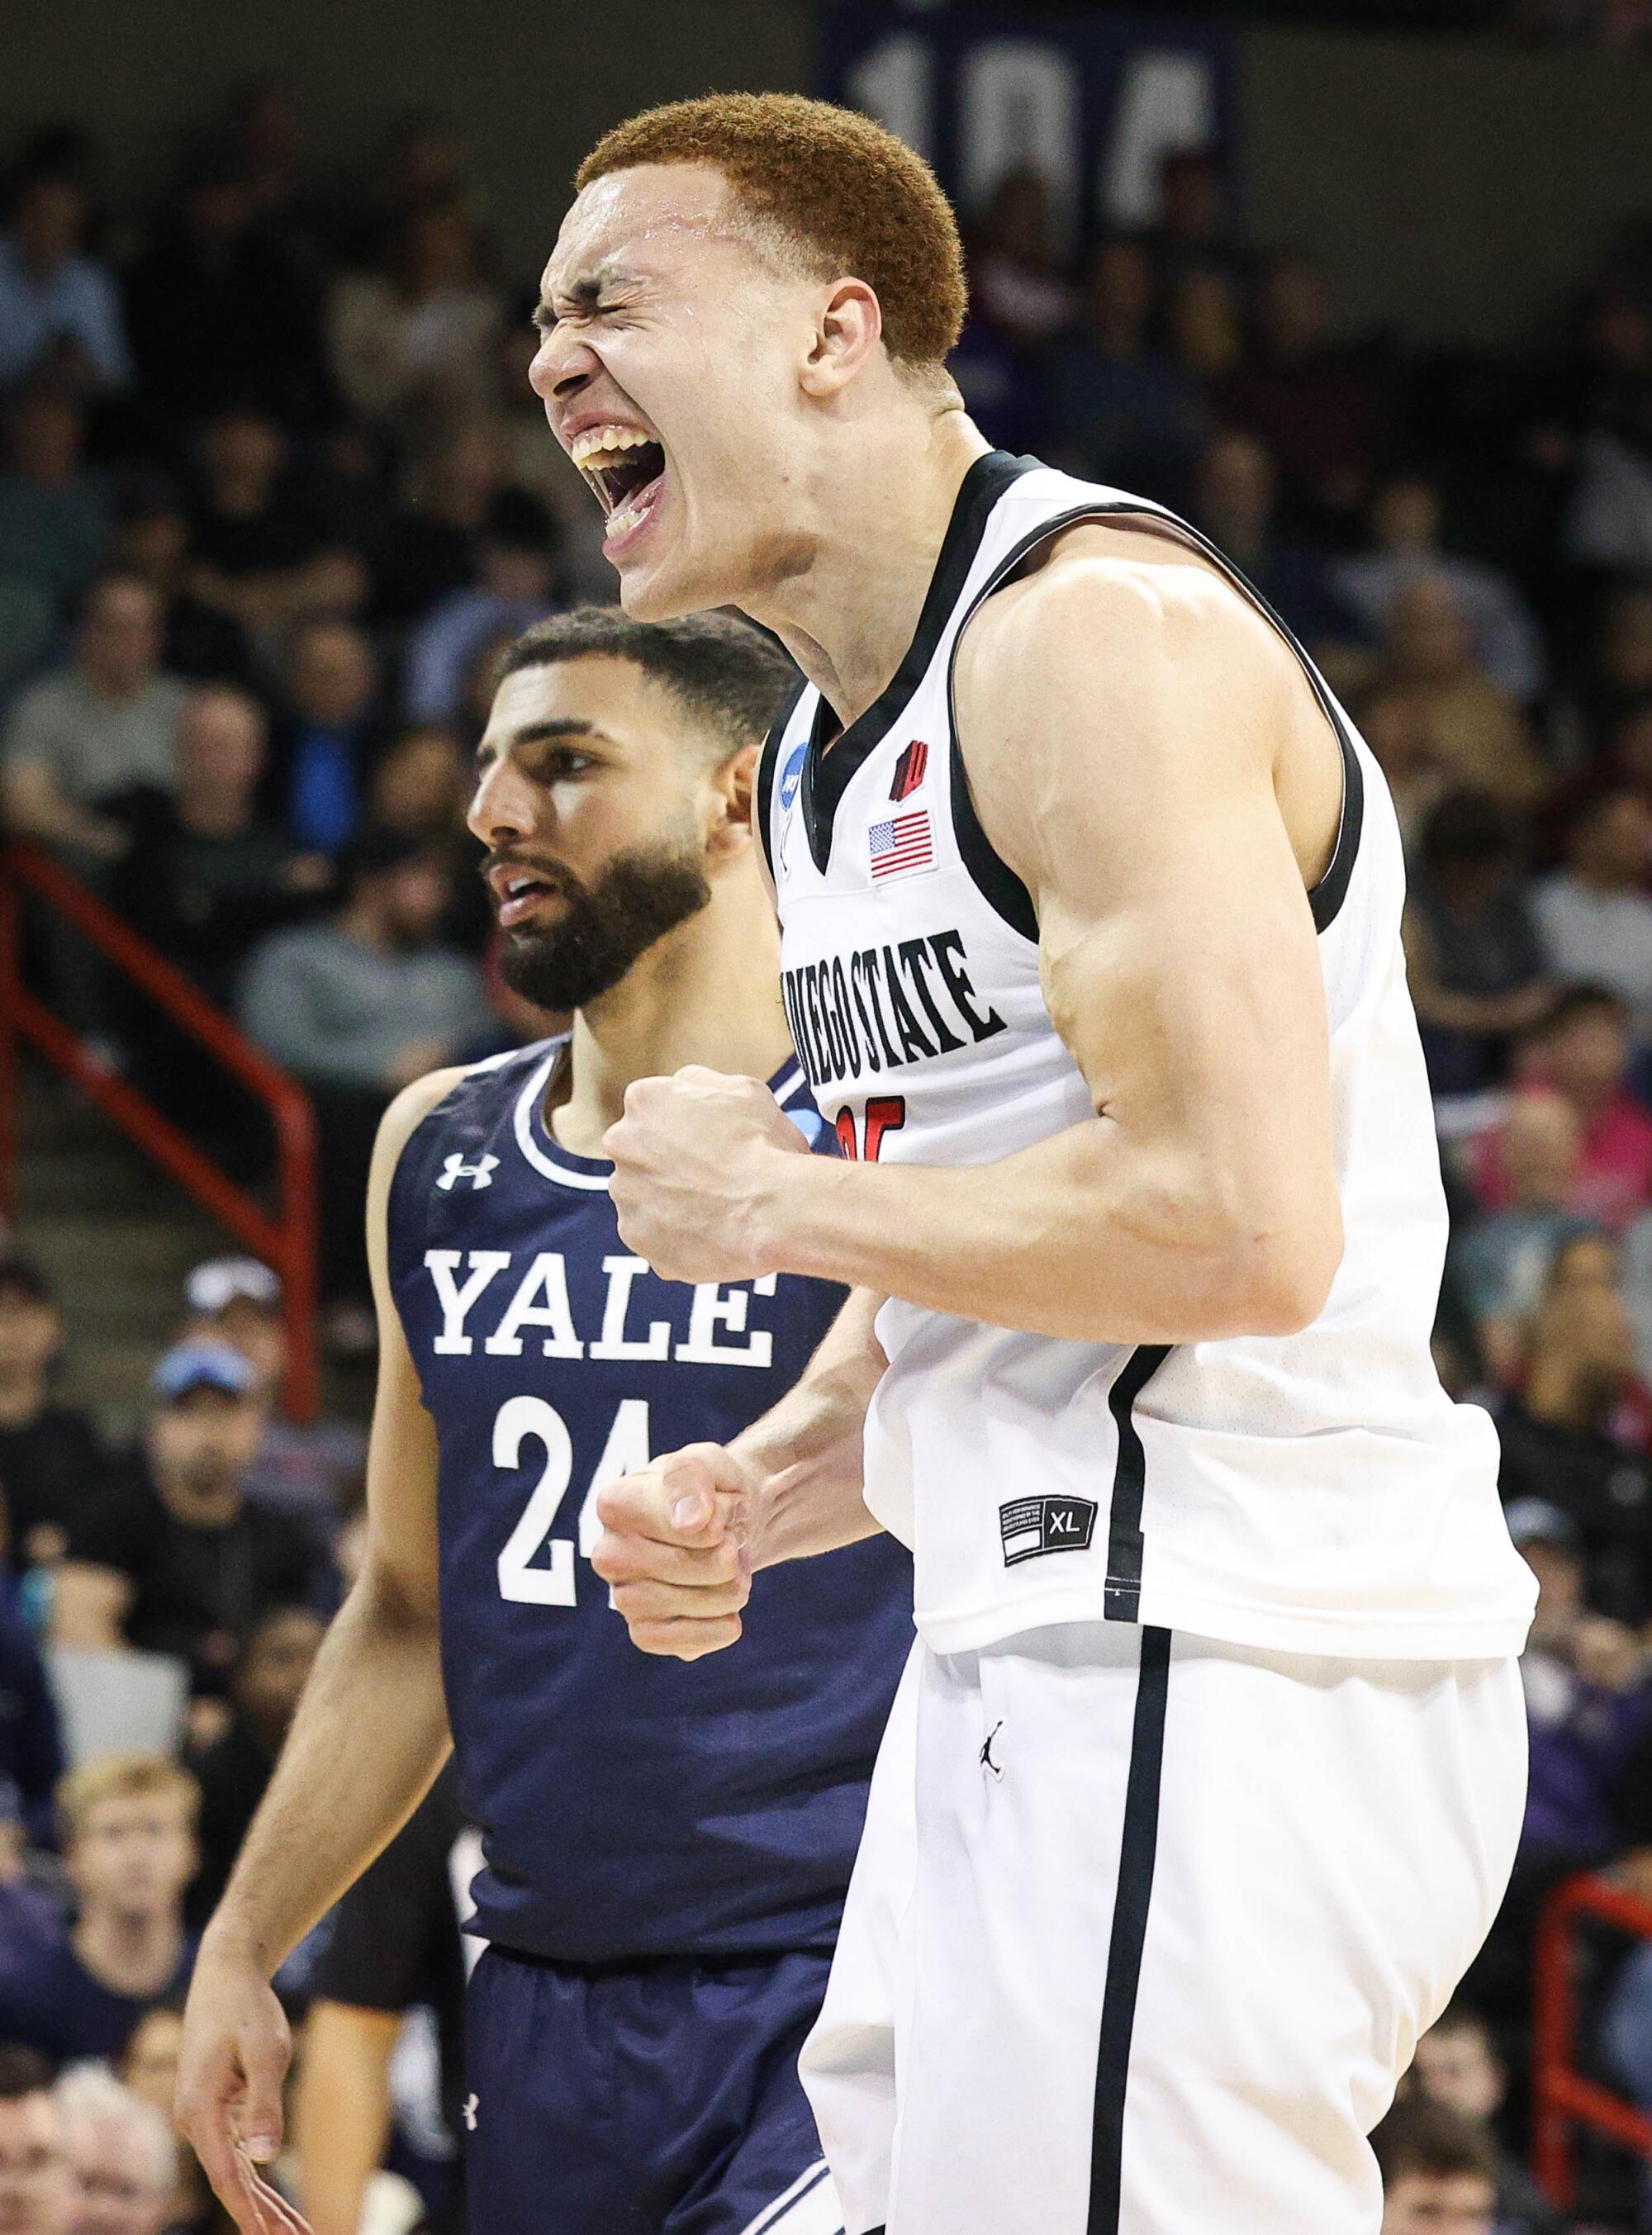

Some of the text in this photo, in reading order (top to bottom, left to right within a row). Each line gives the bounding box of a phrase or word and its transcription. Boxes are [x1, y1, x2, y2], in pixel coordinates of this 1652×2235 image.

[851, 929, 1008, 1073] STATE
[423, 1249, 777, 1368] YALE
[1049, 1511, 1080, 1535] XL
